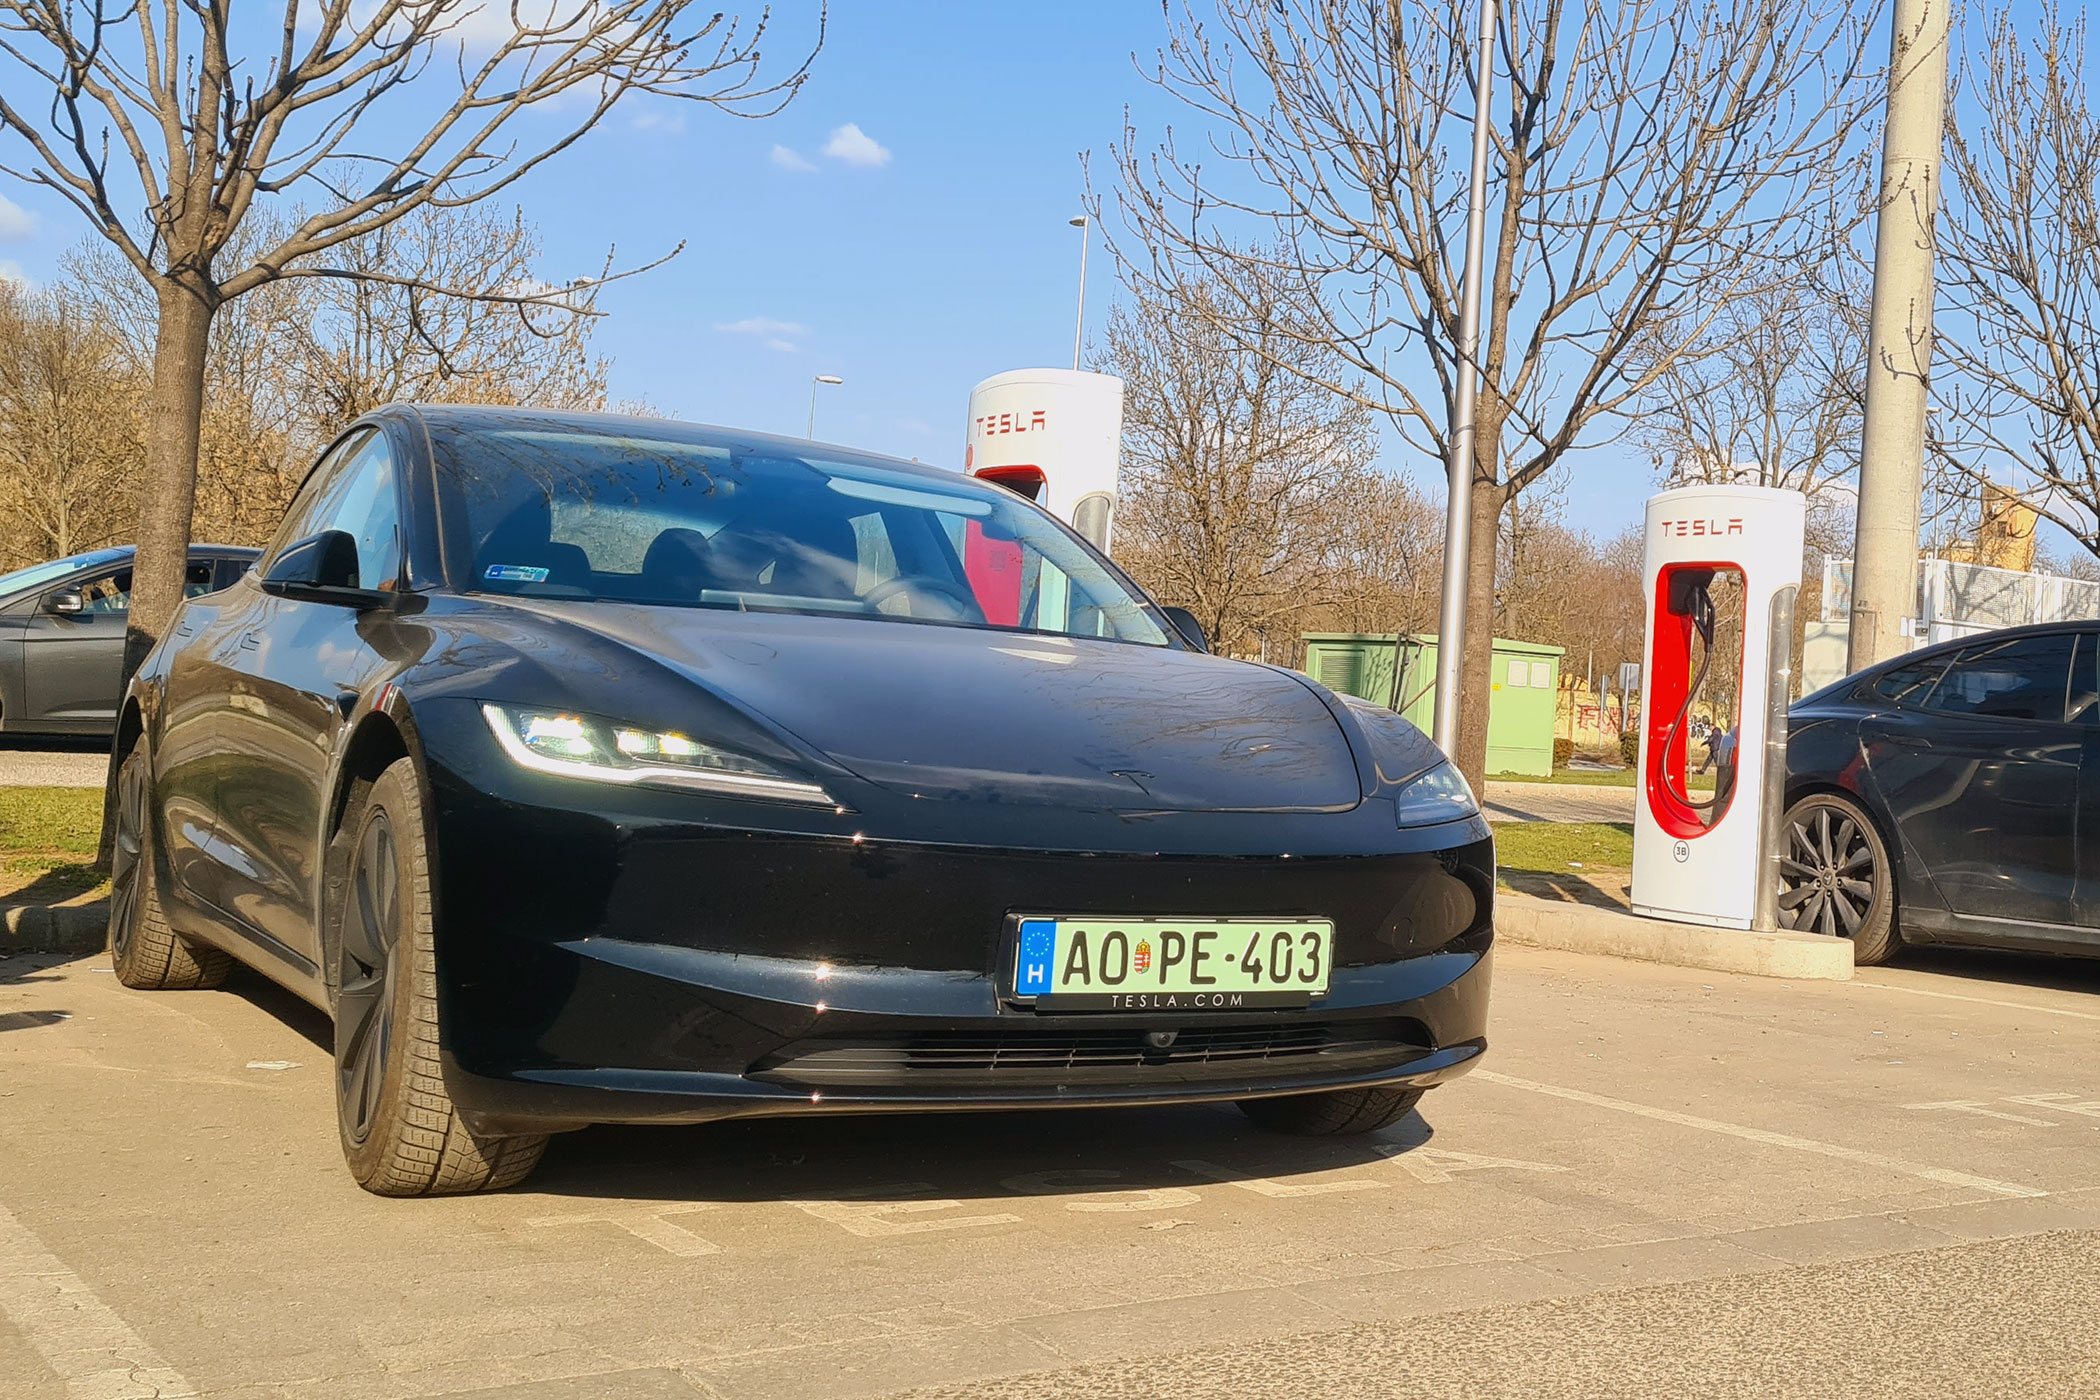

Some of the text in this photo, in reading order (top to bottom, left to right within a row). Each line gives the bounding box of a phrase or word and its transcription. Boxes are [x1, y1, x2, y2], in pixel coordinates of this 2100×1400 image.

[976, 411, 1046, 437] TESLA
[1661, 518, 1743, 537] TESLA
[1676, 847, 1687, 856] 3B
[1062, 930, 1129, 986] AO
[1027, 963, 1044, 984] H
[1112, 994, 1243, 1008] TESLA.COM
[526, 1142, 1572, 1256] TESLA
